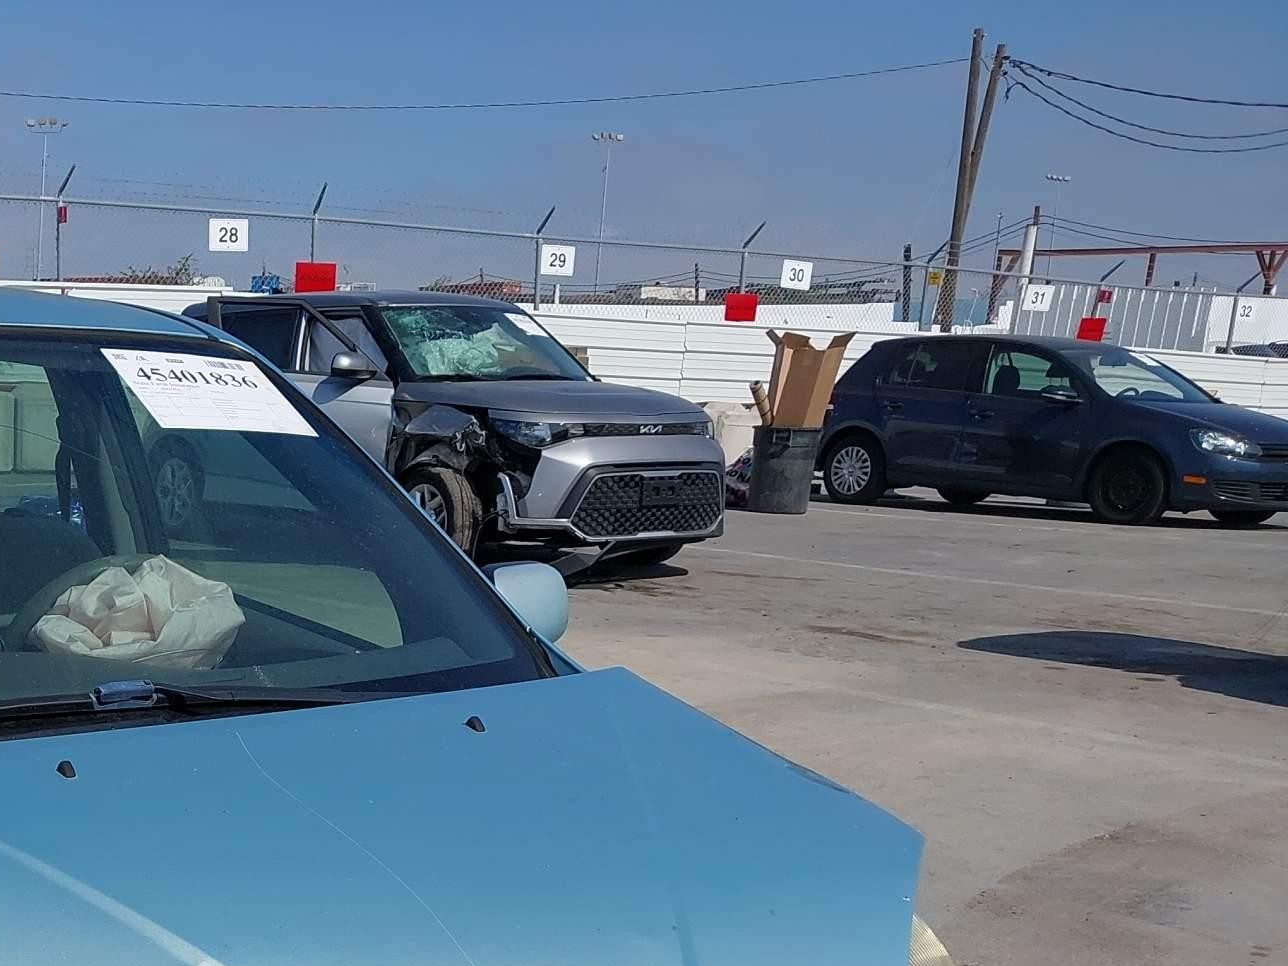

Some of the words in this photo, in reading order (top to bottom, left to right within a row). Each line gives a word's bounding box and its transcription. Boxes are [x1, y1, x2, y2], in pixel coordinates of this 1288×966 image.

[218, 226, 239, 244] 28
[549, 252, 567, 268] 29
[789, 267, 805, 282] 30
[1031, 291, 1046, 305] 31
[1239, 304, 1253, 318] 32
[137, 366, 258, 389] 45401836
